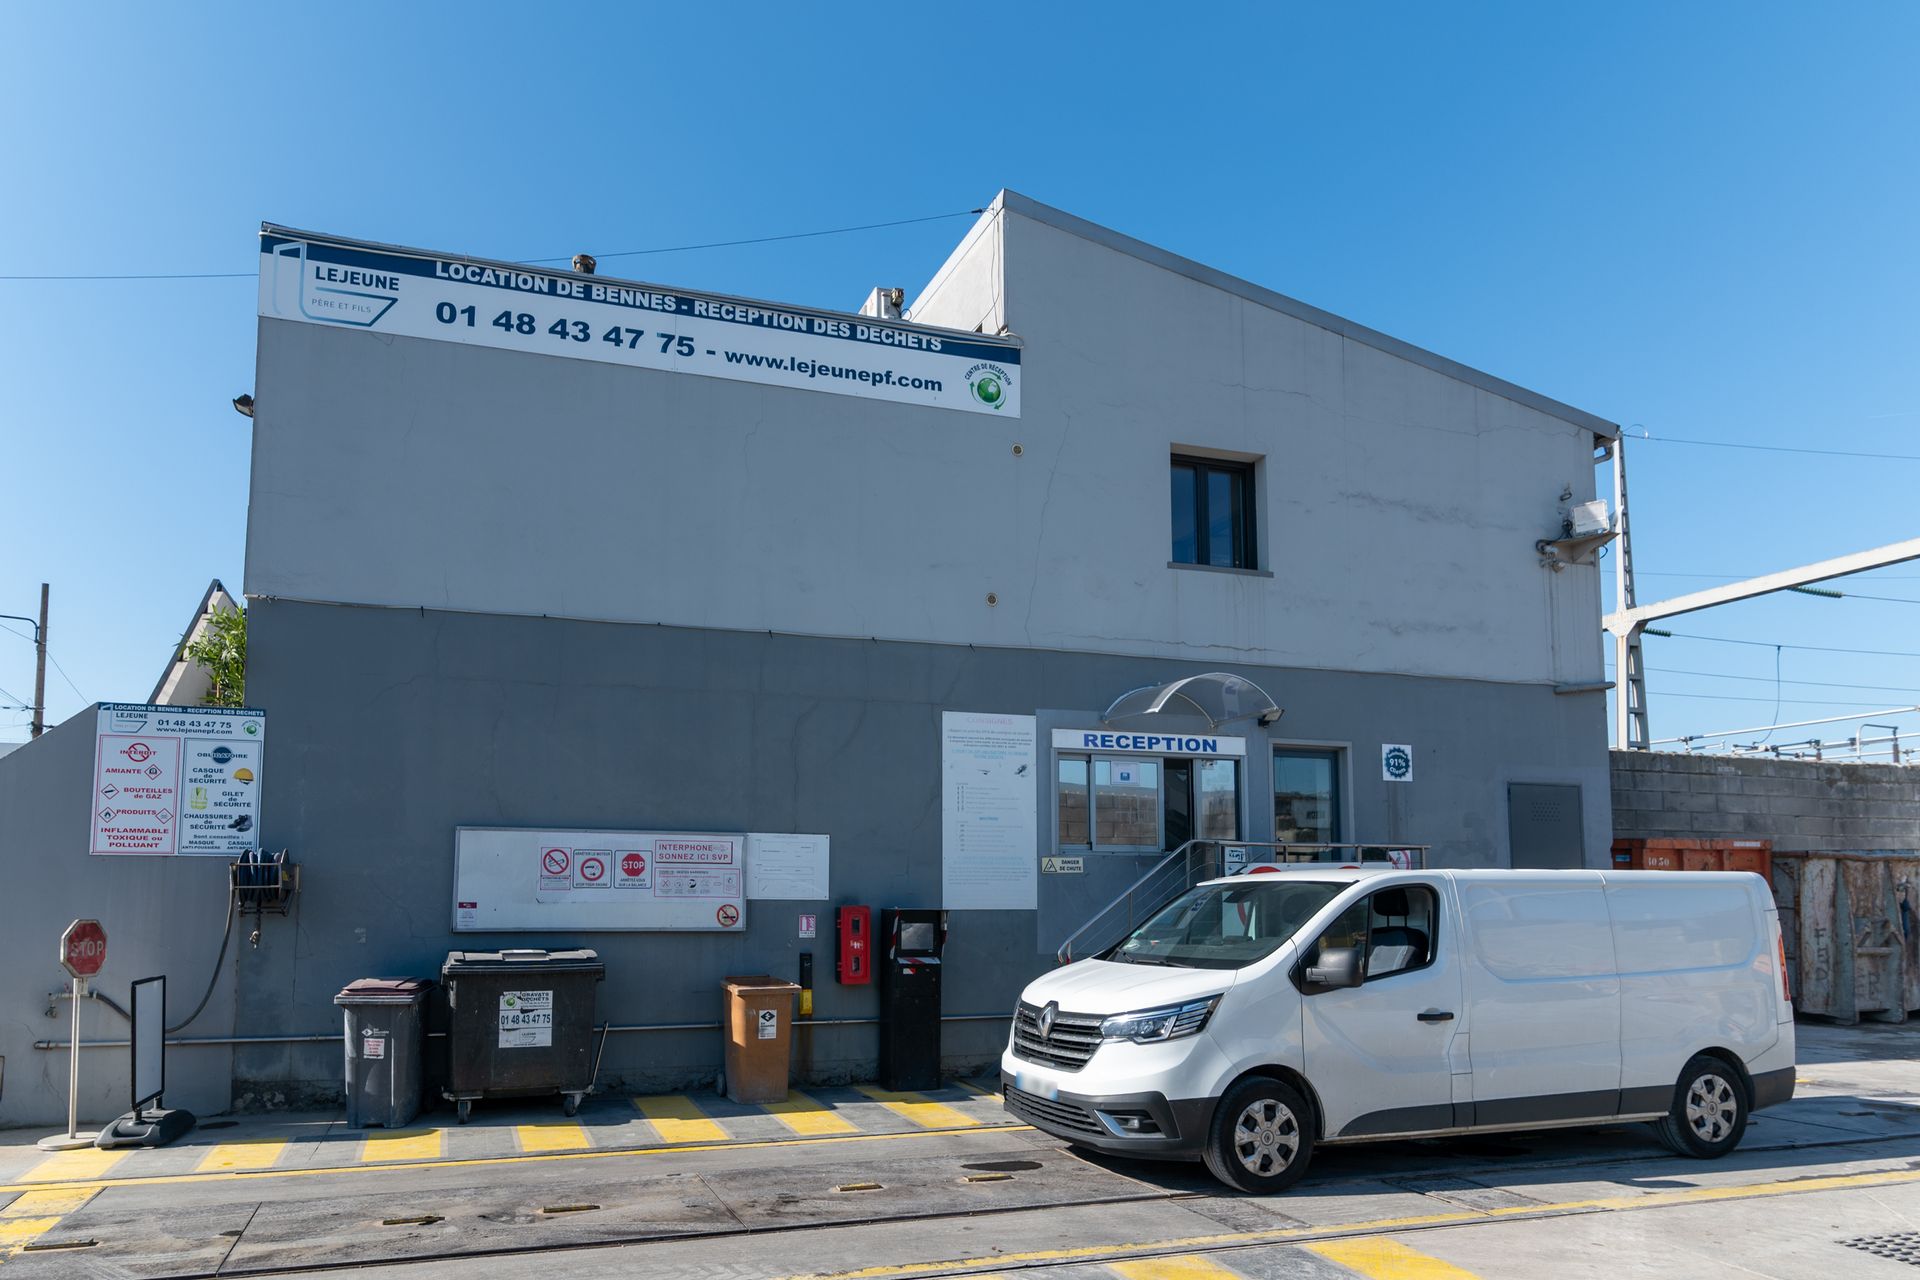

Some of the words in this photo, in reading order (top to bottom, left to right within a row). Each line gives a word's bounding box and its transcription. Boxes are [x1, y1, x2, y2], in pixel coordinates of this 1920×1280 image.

[316, 266, 400, 291] LEJEUNE
[312, 298, 334, 308] PÈRE
[352, 305, 371, 313] FILS
[436, 261, 548, 293] LOCATION
[556, 278, 584, 298] DE
[592, 285, 676, 312] BENNES
[694, 300, 808, 332] RECEPTION
[814, 320, 850, 338] DES
[856, 326, 942, 350] DECHETS
[436, 302, 476, 326] 01
[492, 310, 536, 335] 48
[548, 318, 590, 342] 43
[603, 326, 644, 349] 47
[657, 332, 695, 356] 75
[724, 351, 942, 392] www.lejeunepf.com
[964, 364, 980, 380] CENTRE
[1084, 734, 1217, 752] RECEPTION
[1390, 758, 1406, 766] 91%
[622, 861, 645, 869] STOP
[71, 941, 103, 957] STOP
[501, 1015, 509, 1024] 01
[511, 1015, 520, 1024] 48
[522, 1015, 530, 1024] 43
[532, 1014, 540, 1023] 47
[543, 1014, 550, 1023] 75
